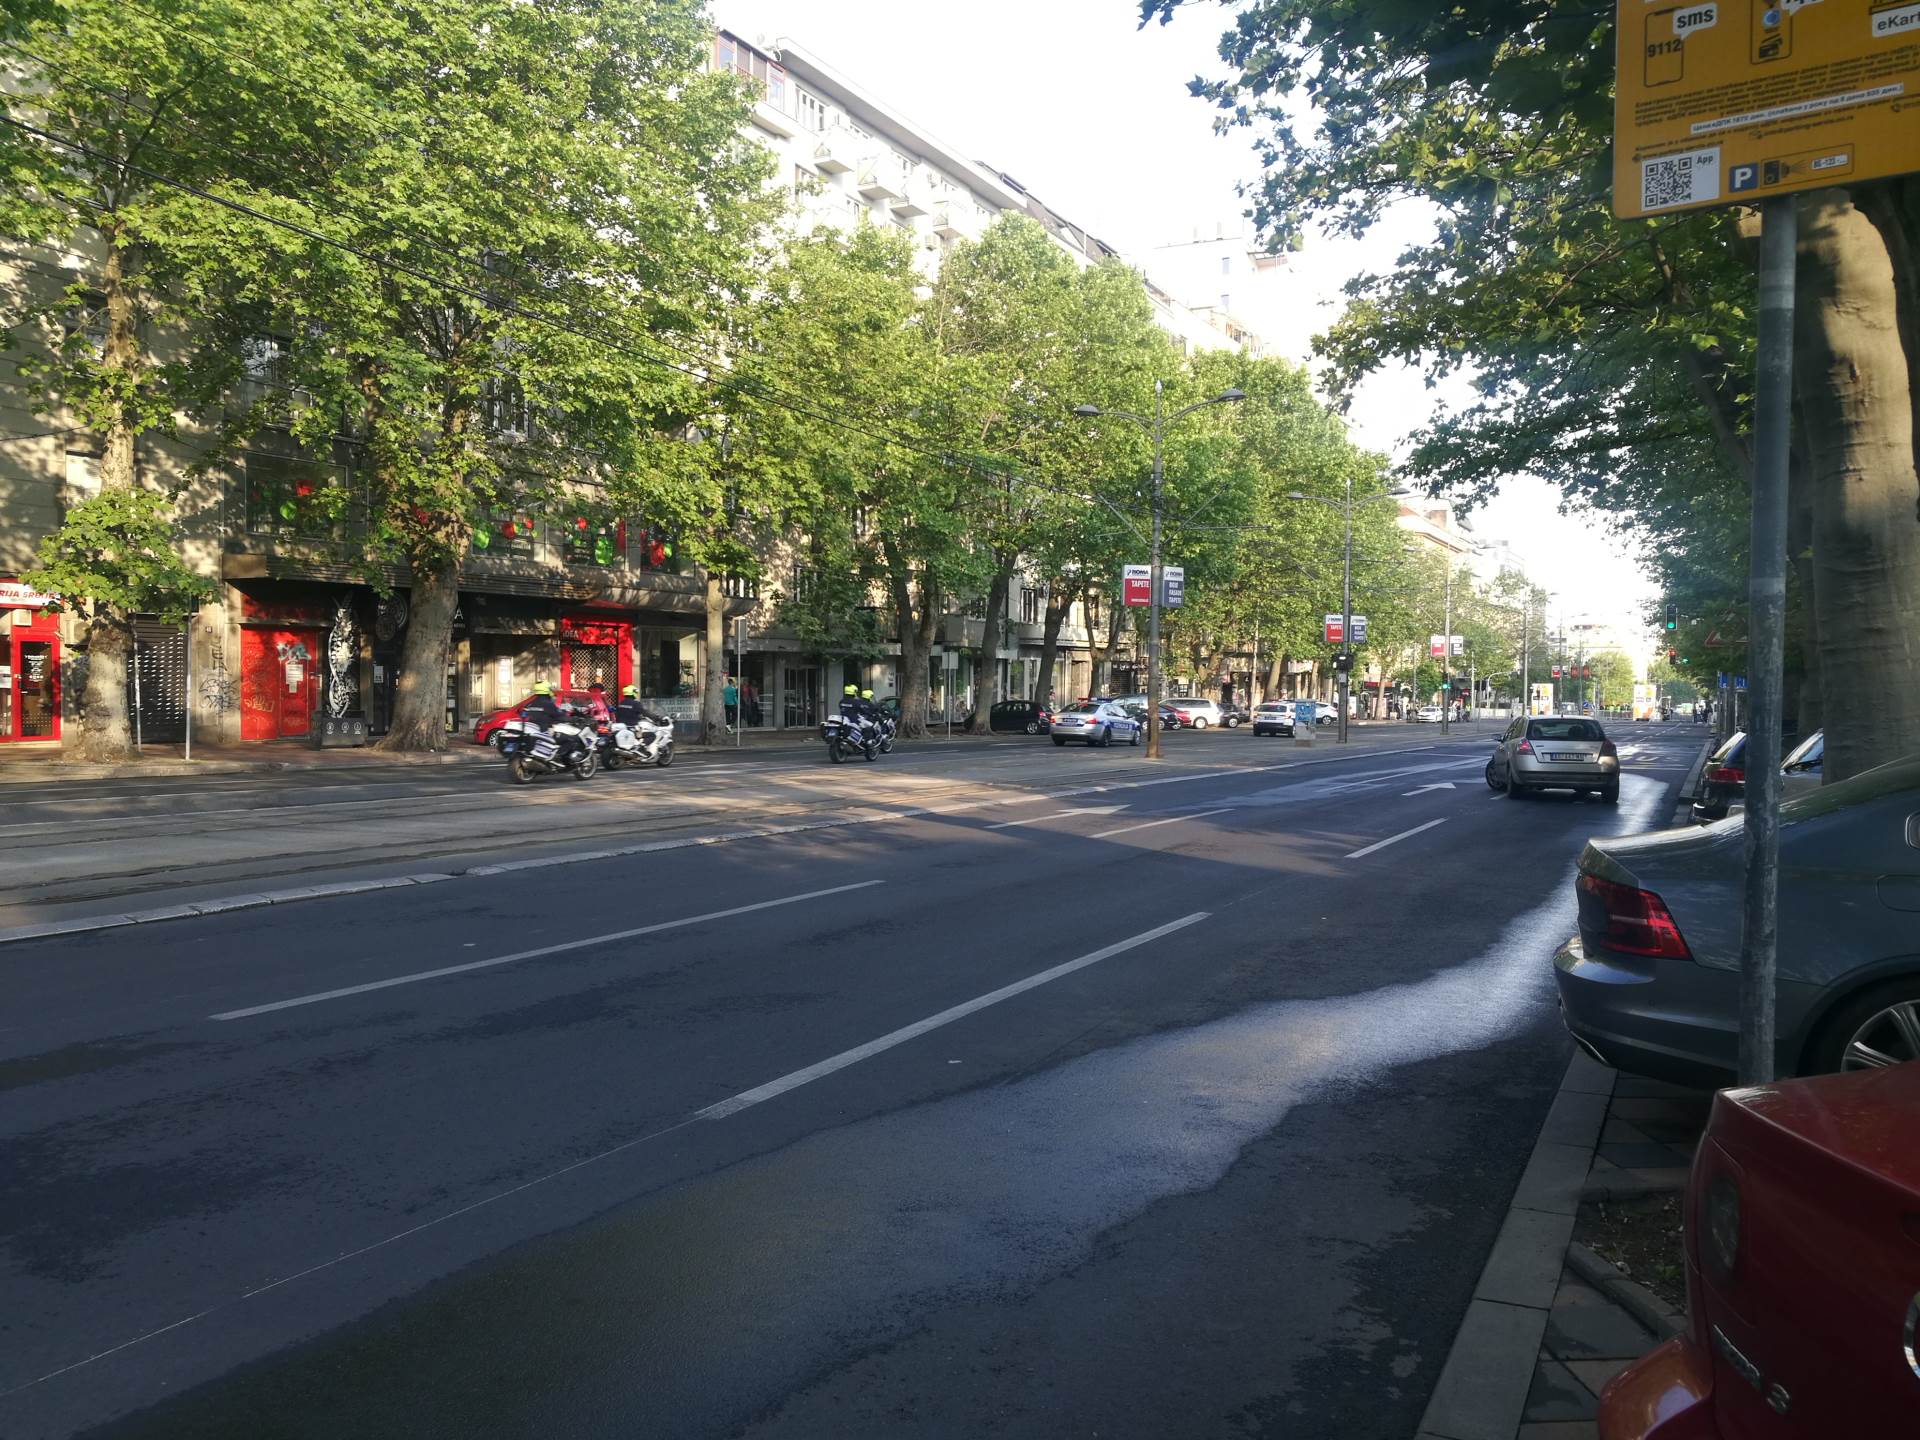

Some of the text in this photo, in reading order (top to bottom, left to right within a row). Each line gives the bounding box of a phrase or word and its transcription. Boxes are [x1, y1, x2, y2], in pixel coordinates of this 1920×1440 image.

[1677, 9, 1714, 29] sms
[1648, 39, 1681, 57] 9112
[1697, 155, 1713, 165] App
[1735, 168, 1752, 188] P
